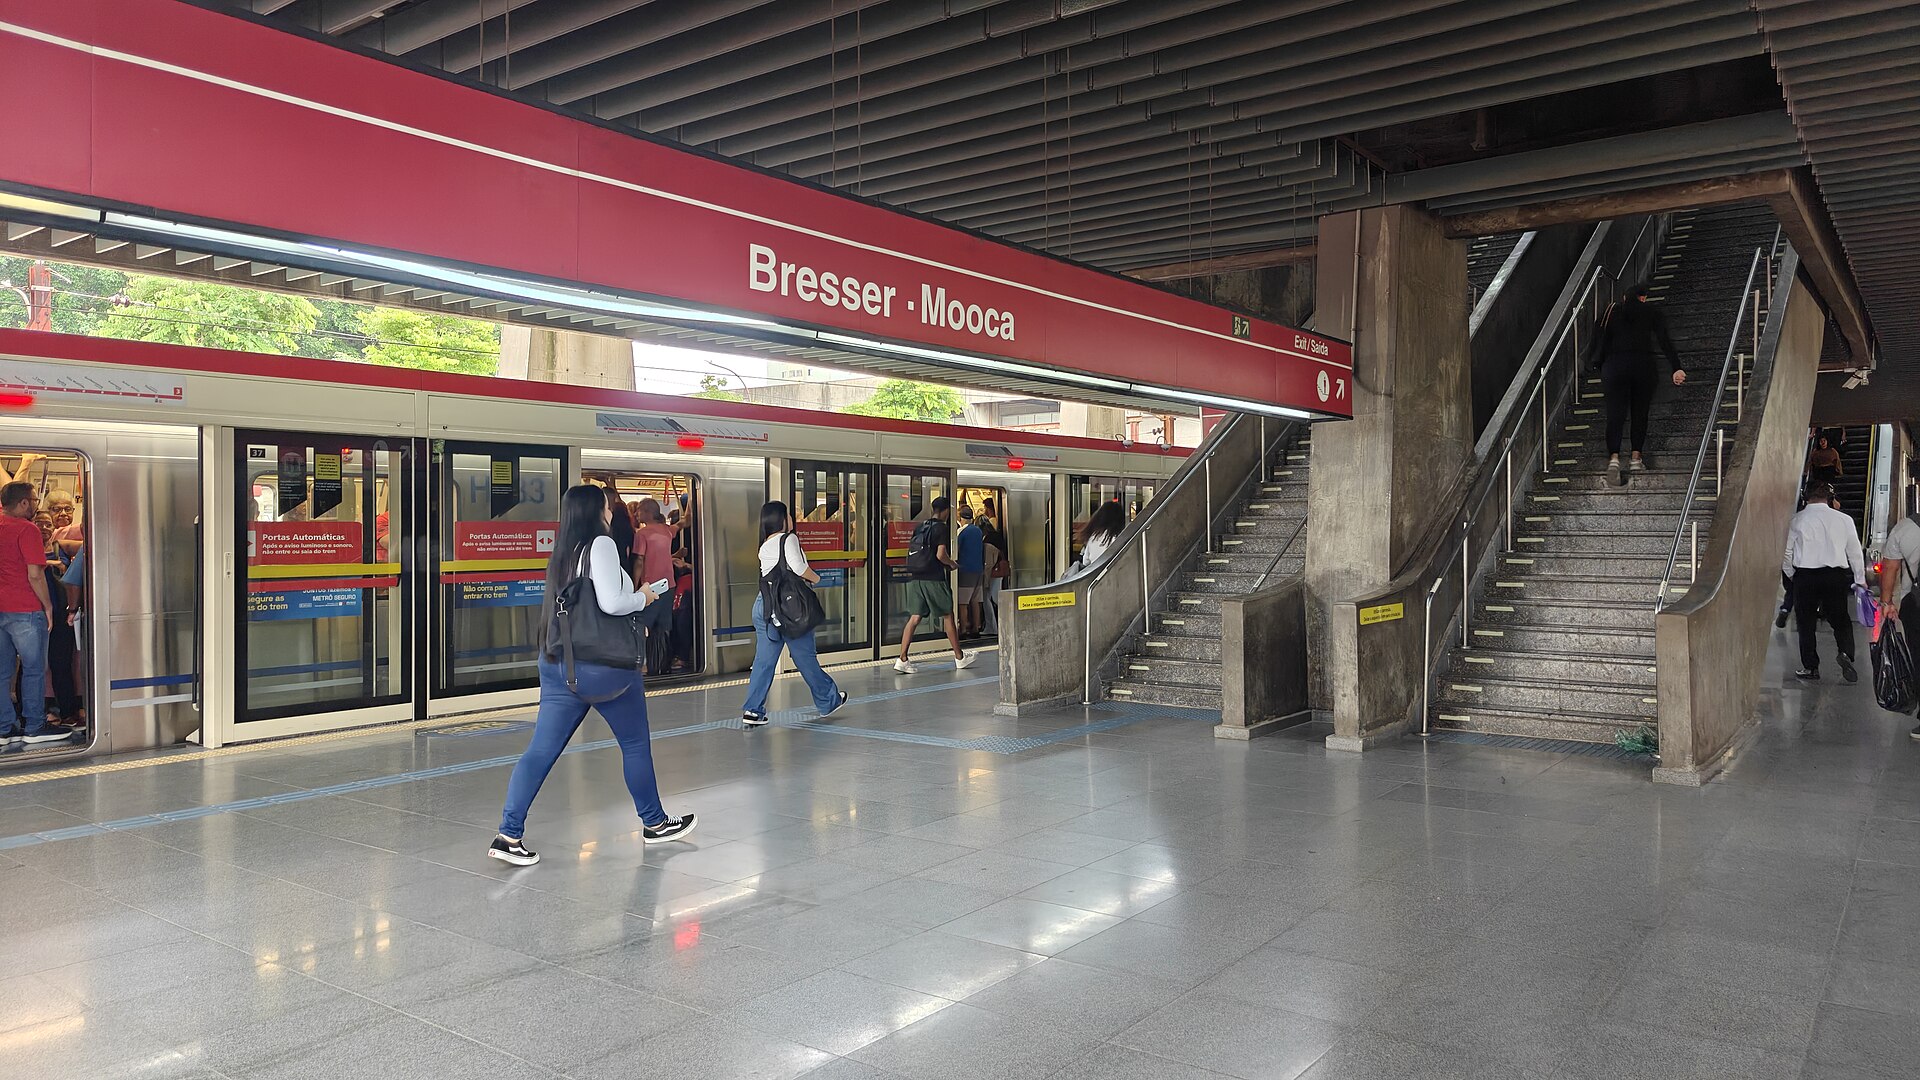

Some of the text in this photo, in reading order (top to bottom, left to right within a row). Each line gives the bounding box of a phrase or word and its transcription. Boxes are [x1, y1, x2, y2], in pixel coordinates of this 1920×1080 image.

[750, 243, 896, 318] Bresser
[921, 283, 1015, 341] Mooca
[252, 449, 263, 457] 37
[262, 532, 345, 541] Portas Automáticas
[257, 603, 269, 611] do
